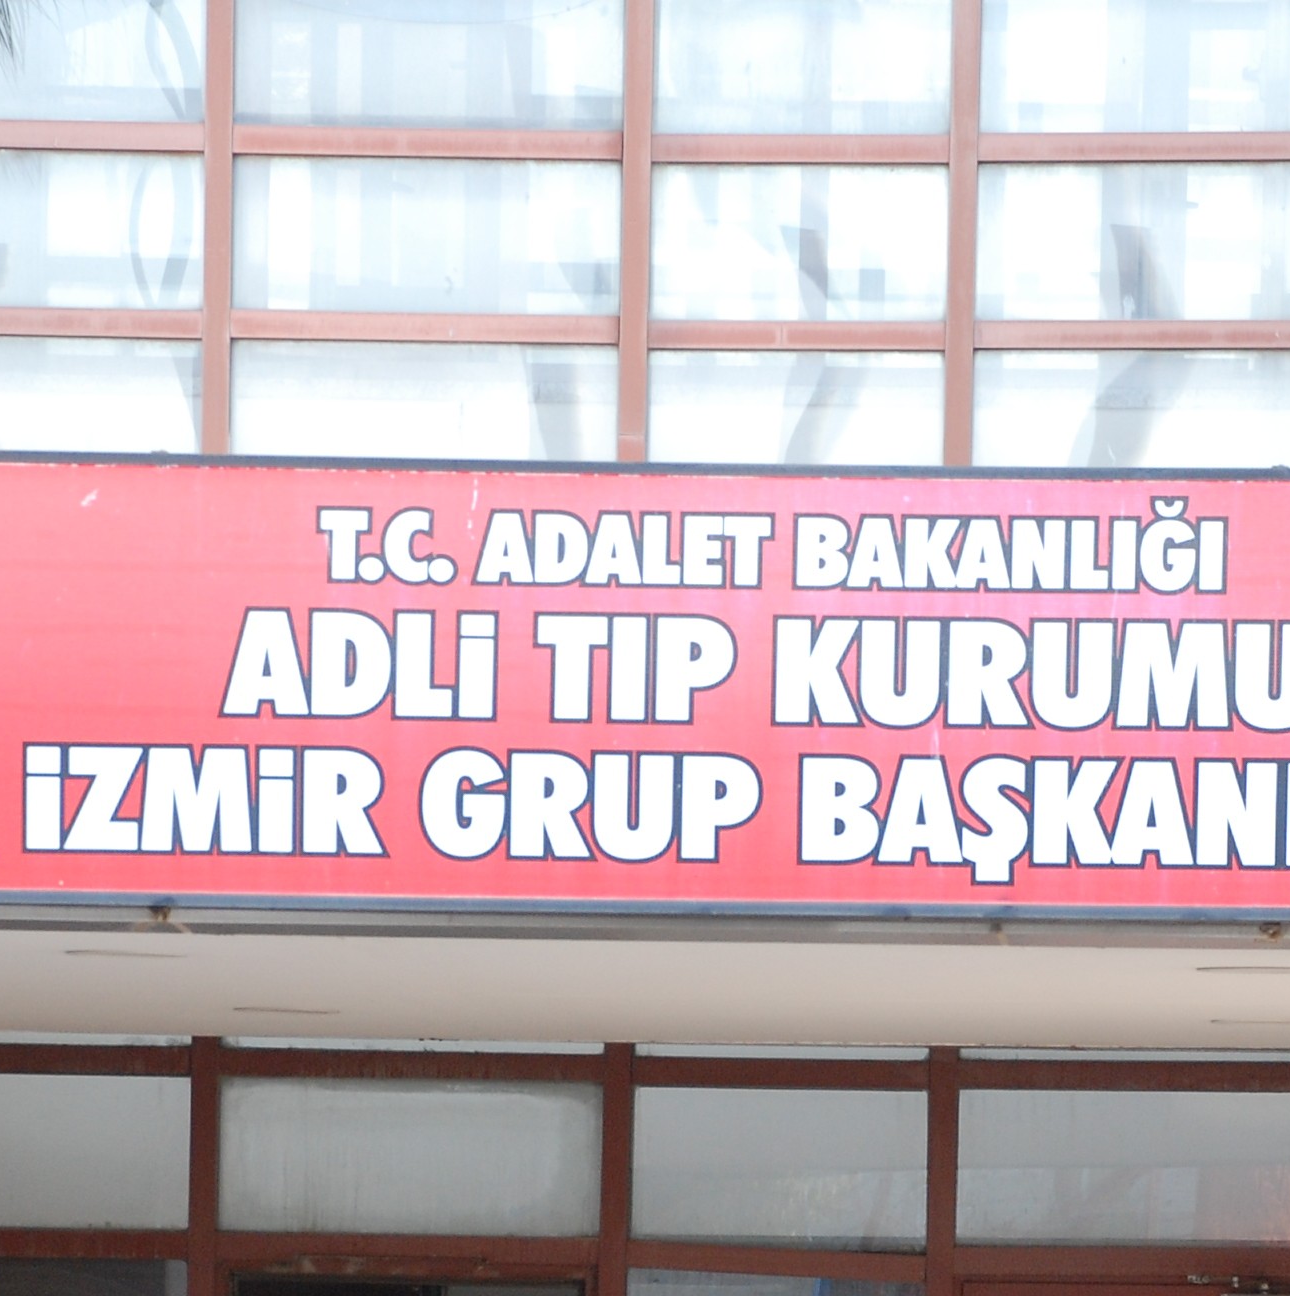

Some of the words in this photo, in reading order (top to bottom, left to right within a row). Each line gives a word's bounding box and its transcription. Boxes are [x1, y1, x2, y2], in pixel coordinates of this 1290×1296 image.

[317, 507, 457, 586] T.C.
[472, 510, 775, 590] ADALET
[792, 496, 1229, 594] BAKANLIĞI
[218, 608, 499, 722] ADLİ
[534, 611, 739, 725] TIP
[22, 741, 390, 858] İZMİR
[418, 747, 763, 863] GRUP
